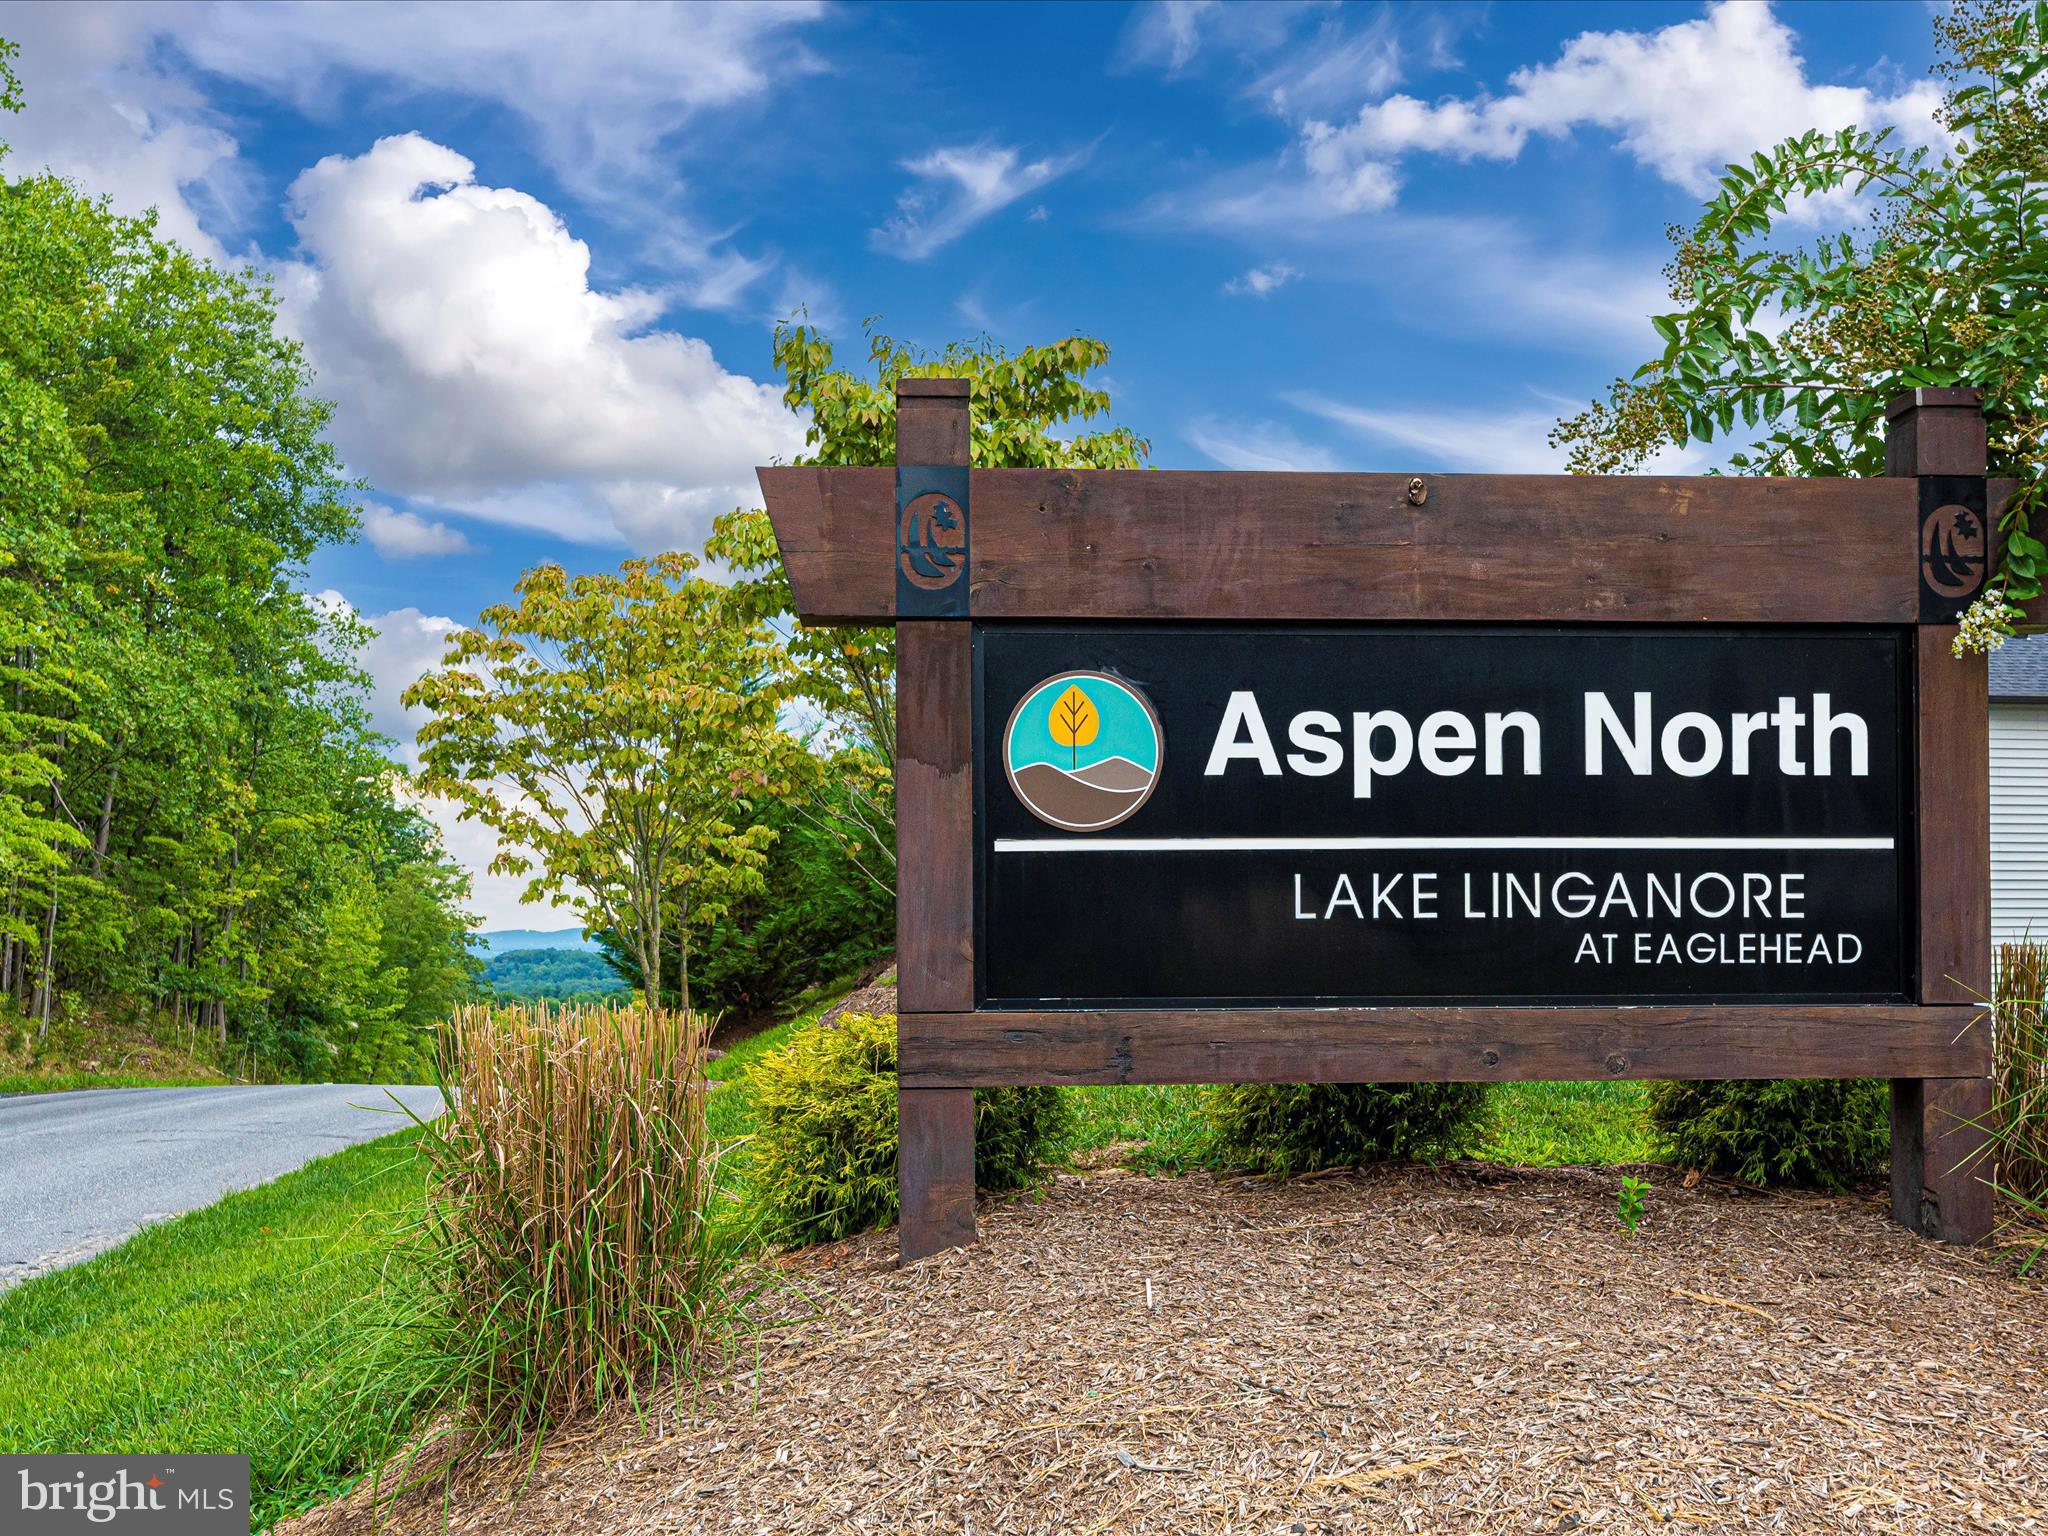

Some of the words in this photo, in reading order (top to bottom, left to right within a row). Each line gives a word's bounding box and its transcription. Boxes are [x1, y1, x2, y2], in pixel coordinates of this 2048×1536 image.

[1203, 690, 1542, 799] Aspen
[1584, 690, 1869, 778] North
[1293, 872, 1438, 920] LAKE
[1463, 871, 1806, 919] LINGANORE
[1574, 932, 1619, 964] AT
[1633, 932, 1863, 965] EAGLEHEAD
